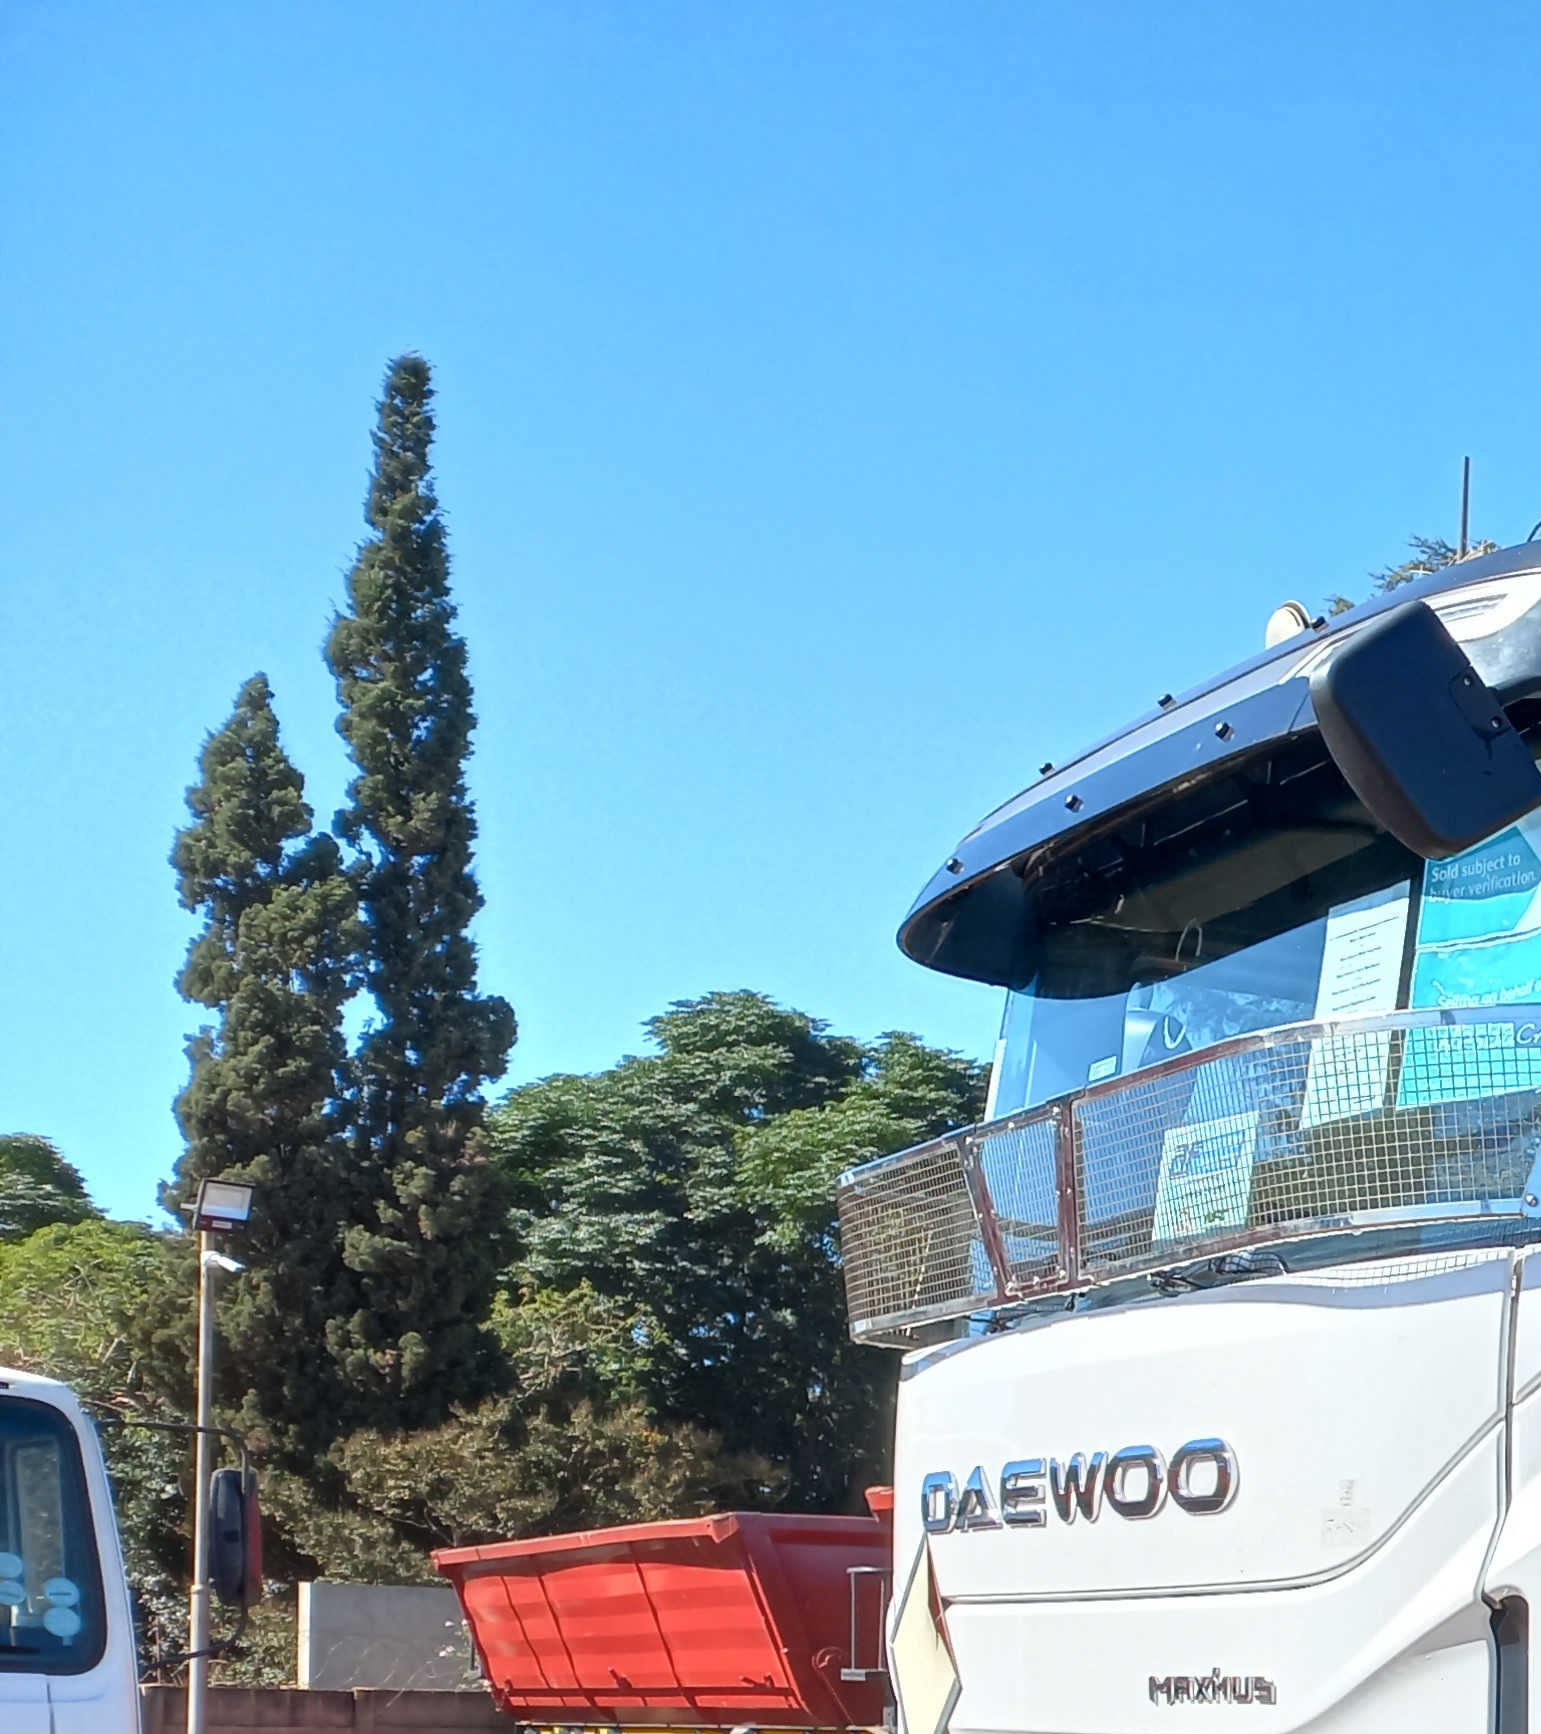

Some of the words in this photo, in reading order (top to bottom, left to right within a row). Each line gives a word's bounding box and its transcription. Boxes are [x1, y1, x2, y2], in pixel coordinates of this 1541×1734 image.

[1431, 864, 1459, 882] Sold
[1462, 855, 1505, 877] subject
[1508, 853, 1521, 866] to
[921, 1437, 1240, 1535] DAEWOO
